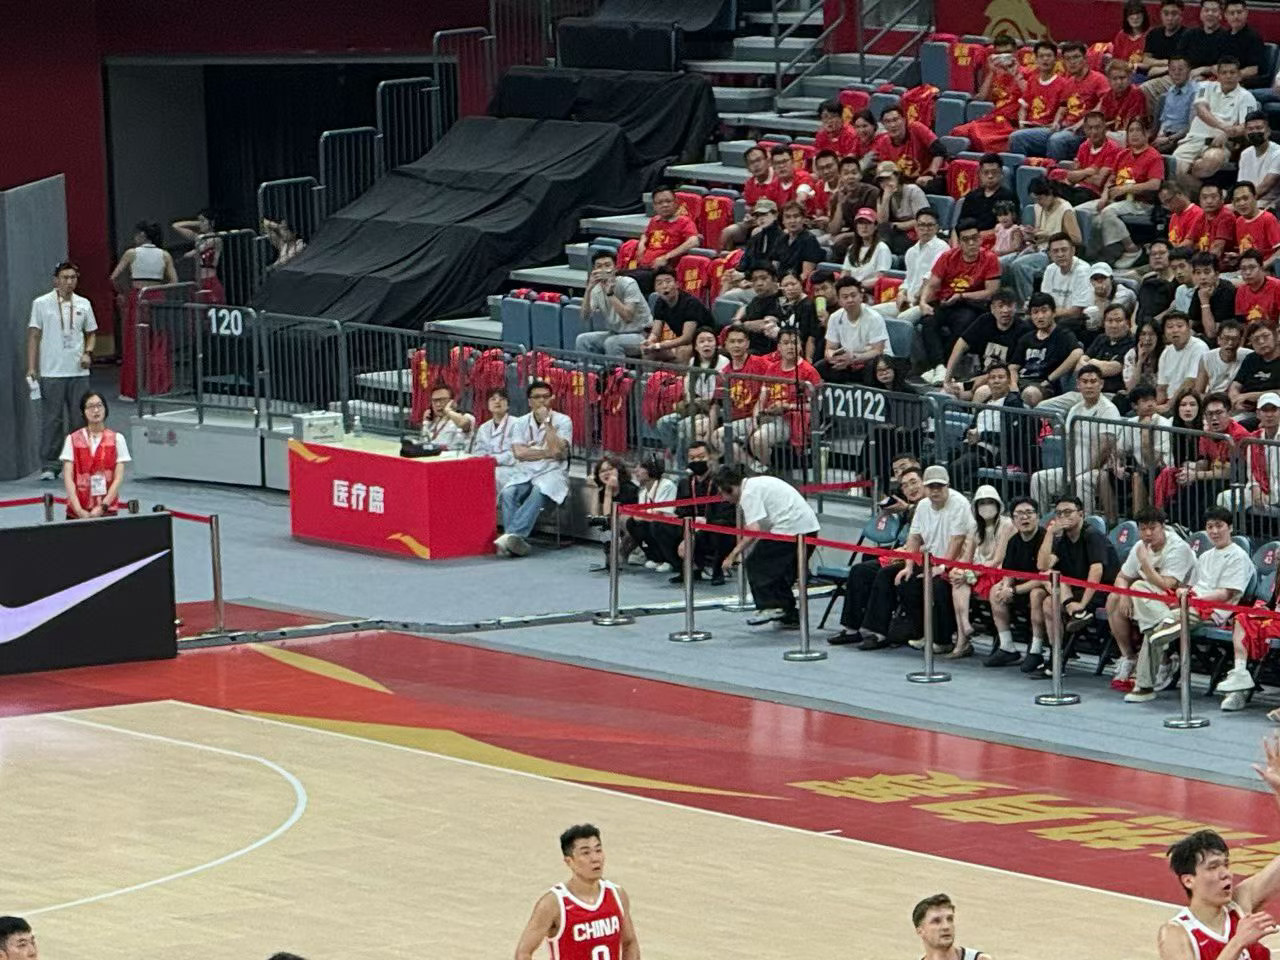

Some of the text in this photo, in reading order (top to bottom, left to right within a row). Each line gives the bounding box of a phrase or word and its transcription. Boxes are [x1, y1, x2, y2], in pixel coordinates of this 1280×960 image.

[208, 308, 243, 336] 120
[332, 479, 385, 514] 医疗席
[573, 915, 621, 942] CHINA
